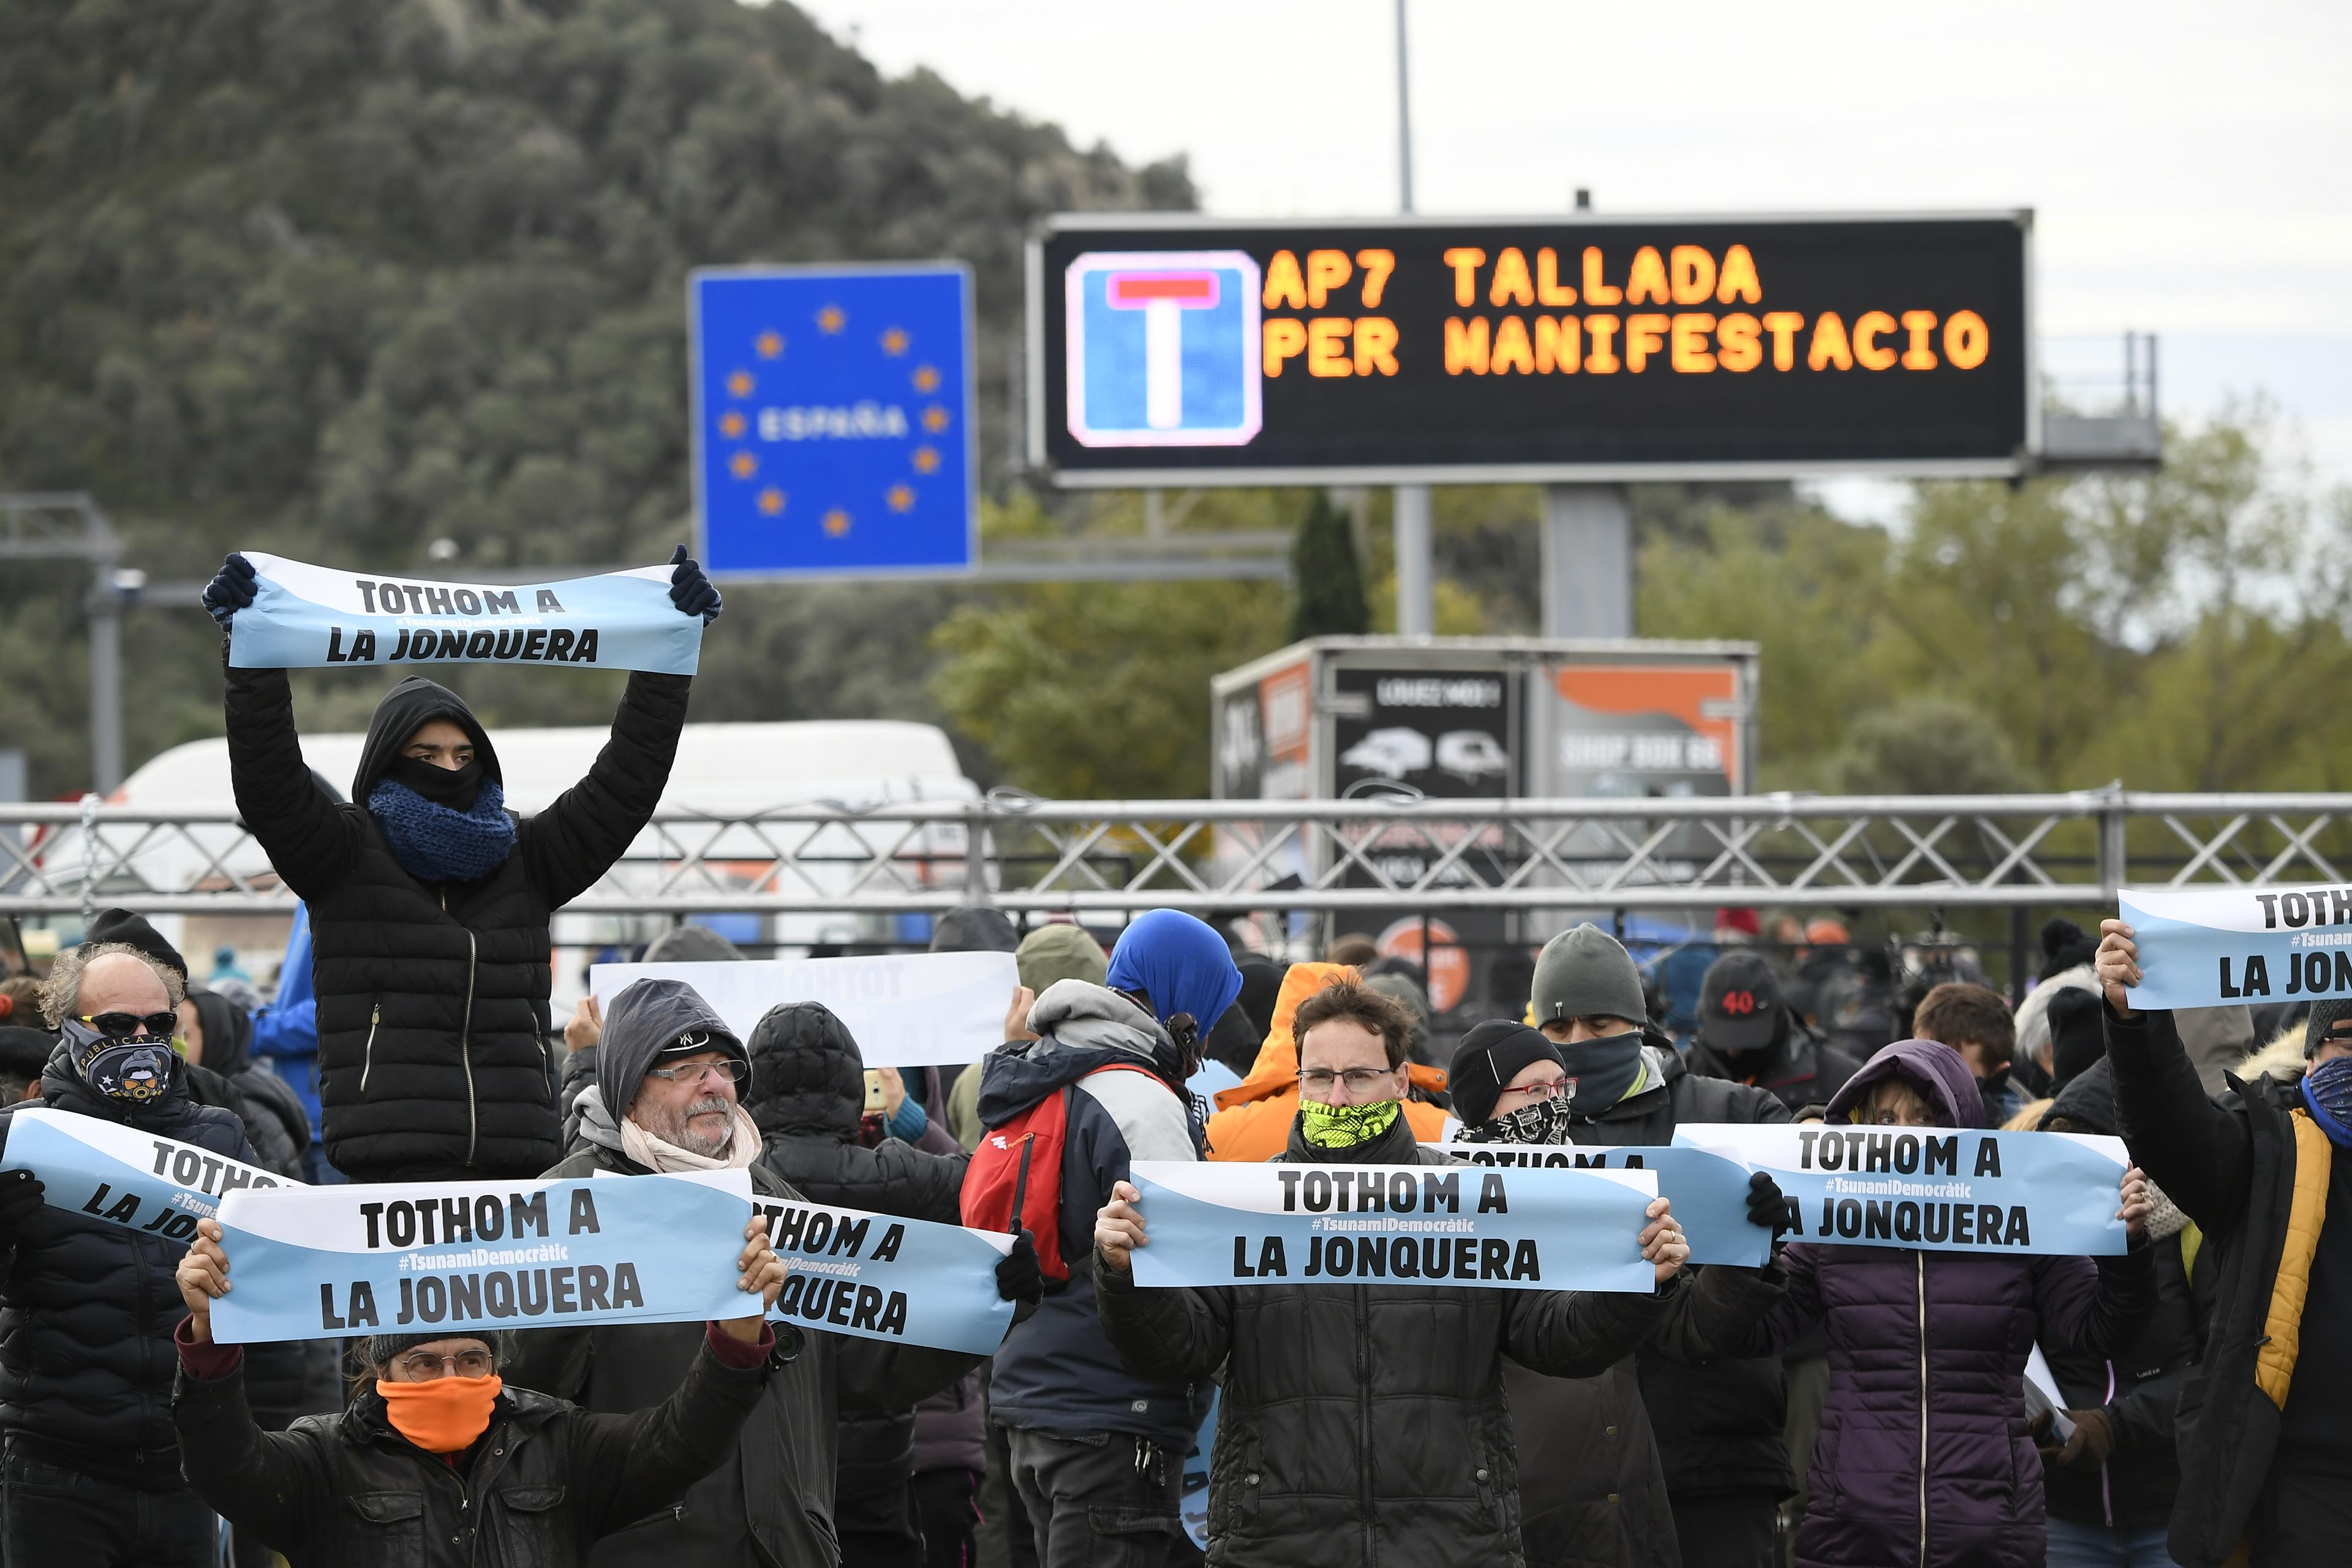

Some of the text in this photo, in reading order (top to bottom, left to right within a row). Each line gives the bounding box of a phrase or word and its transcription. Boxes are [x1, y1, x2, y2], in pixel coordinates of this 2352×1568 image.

[1263, 245, 1762, 309] AP7 TALLADA
[1263, 310, 1989, 377] PER MANIFESTACIO
[758, 401, 908, 442] ESPAÑA
[356, 580, 566, 615] TOTHOM A
[326, 627, 598, 663] LA JONQUERA
[2220, 955, 2270, 998] LA
[1722, 990, 1754, 1015] 40
[80, 1036, 145, 1084] EPÚBLICA
[1799, 1131, 2002, 1177] TOTHOM A
[1278, 1171, 1508, 1213] TOTHOM A
[1825, 1177, 1971, 1199] #TsunamiDemocràtic
[82, 1183, 199, 1243] LA JO
[360, 1188, 600, 1249] TOTHOM A
[753, 1202, 905, 1262] THOM A
[1311, 1217, 1474, 1232] #TsunamiDemocràtic
[1783, 1196, 2030, 1247] A JONQUERA
[399, 1245, 568, 1272] #TsunamiDemocràtic
[1234, 1236, 1541, 1281] LA JONQUERA
[320, 1262, 644, 1330] LA JONQUERA
[777, 1274, 907, 1336] QUERA
